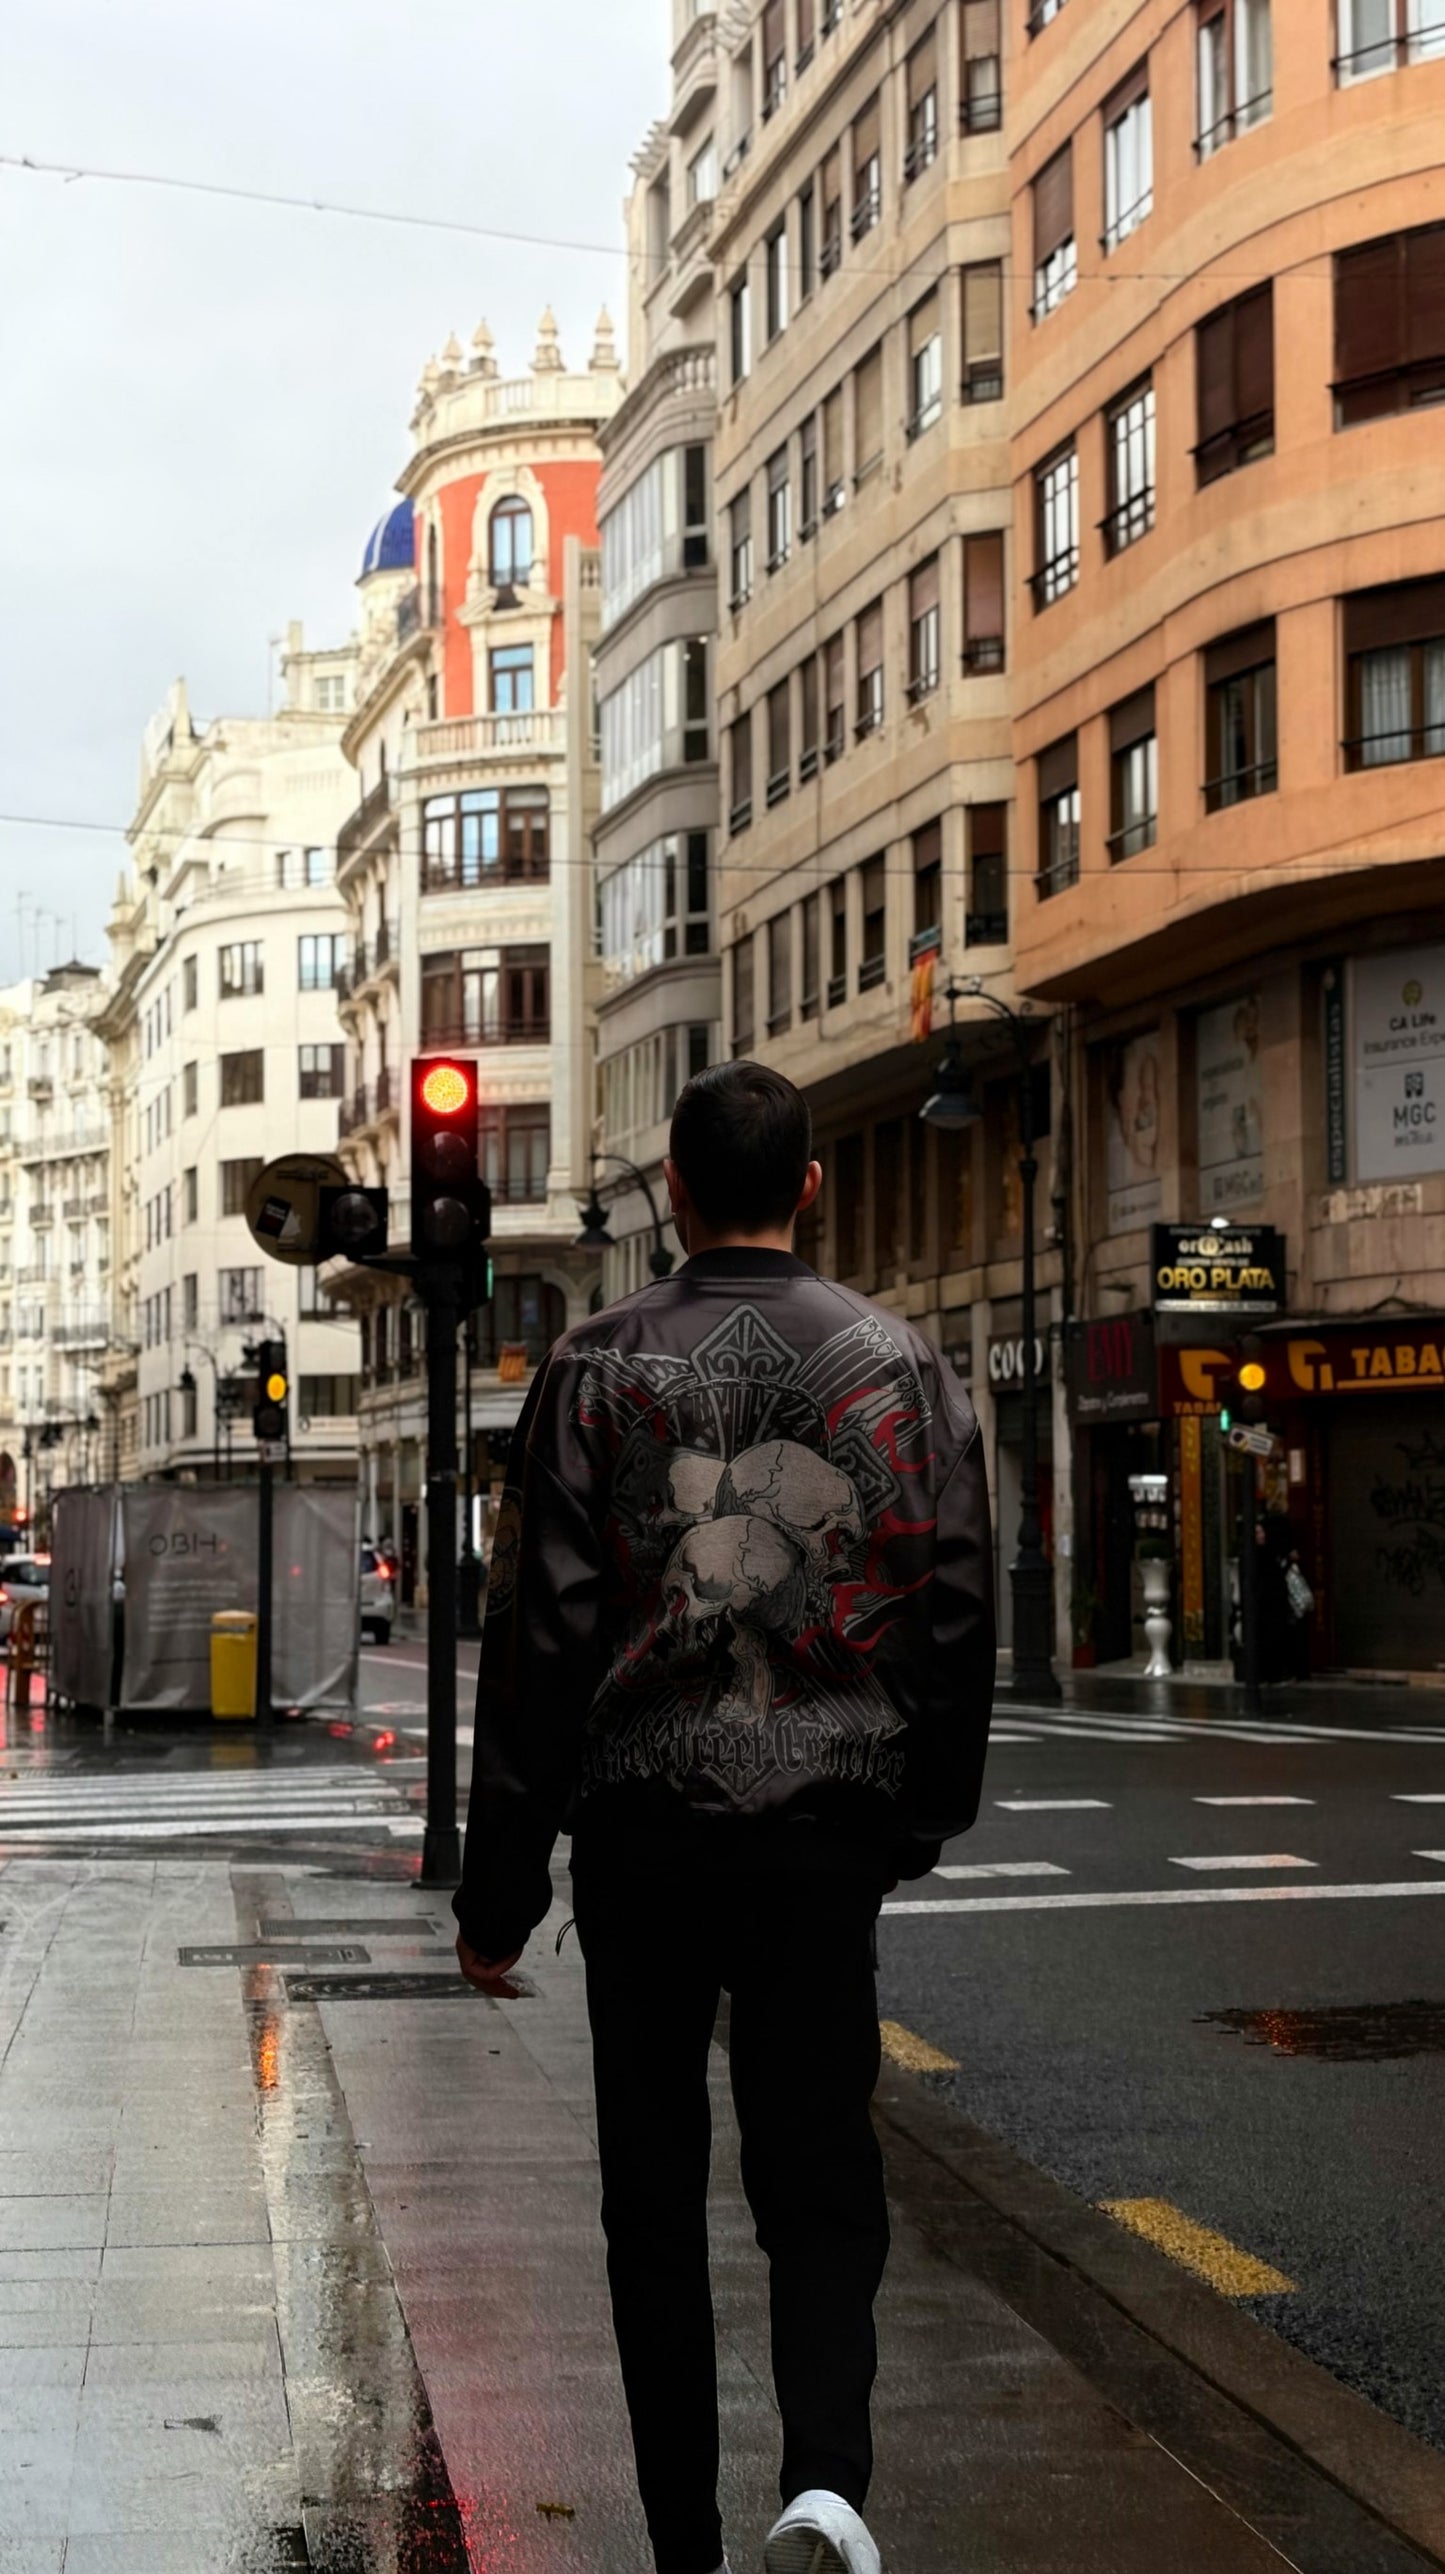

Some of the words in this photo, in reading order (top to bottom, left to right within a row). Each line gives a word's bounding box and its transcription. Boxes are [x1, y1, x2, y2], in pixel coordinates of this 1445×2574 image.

[1389, 1017, 1407, 1031] CA
[1412, 1012, 1437, 1028] Life
[1364, 1036, 1417, 1054] Insurance
[1393, 1103, 1436, 1128] MGC
[1157, 1266, 1207, 1290] ORO
[1211, 1266, 1275, 1290] PLATA
[1351, 1342, 1445, 1378] TABA
